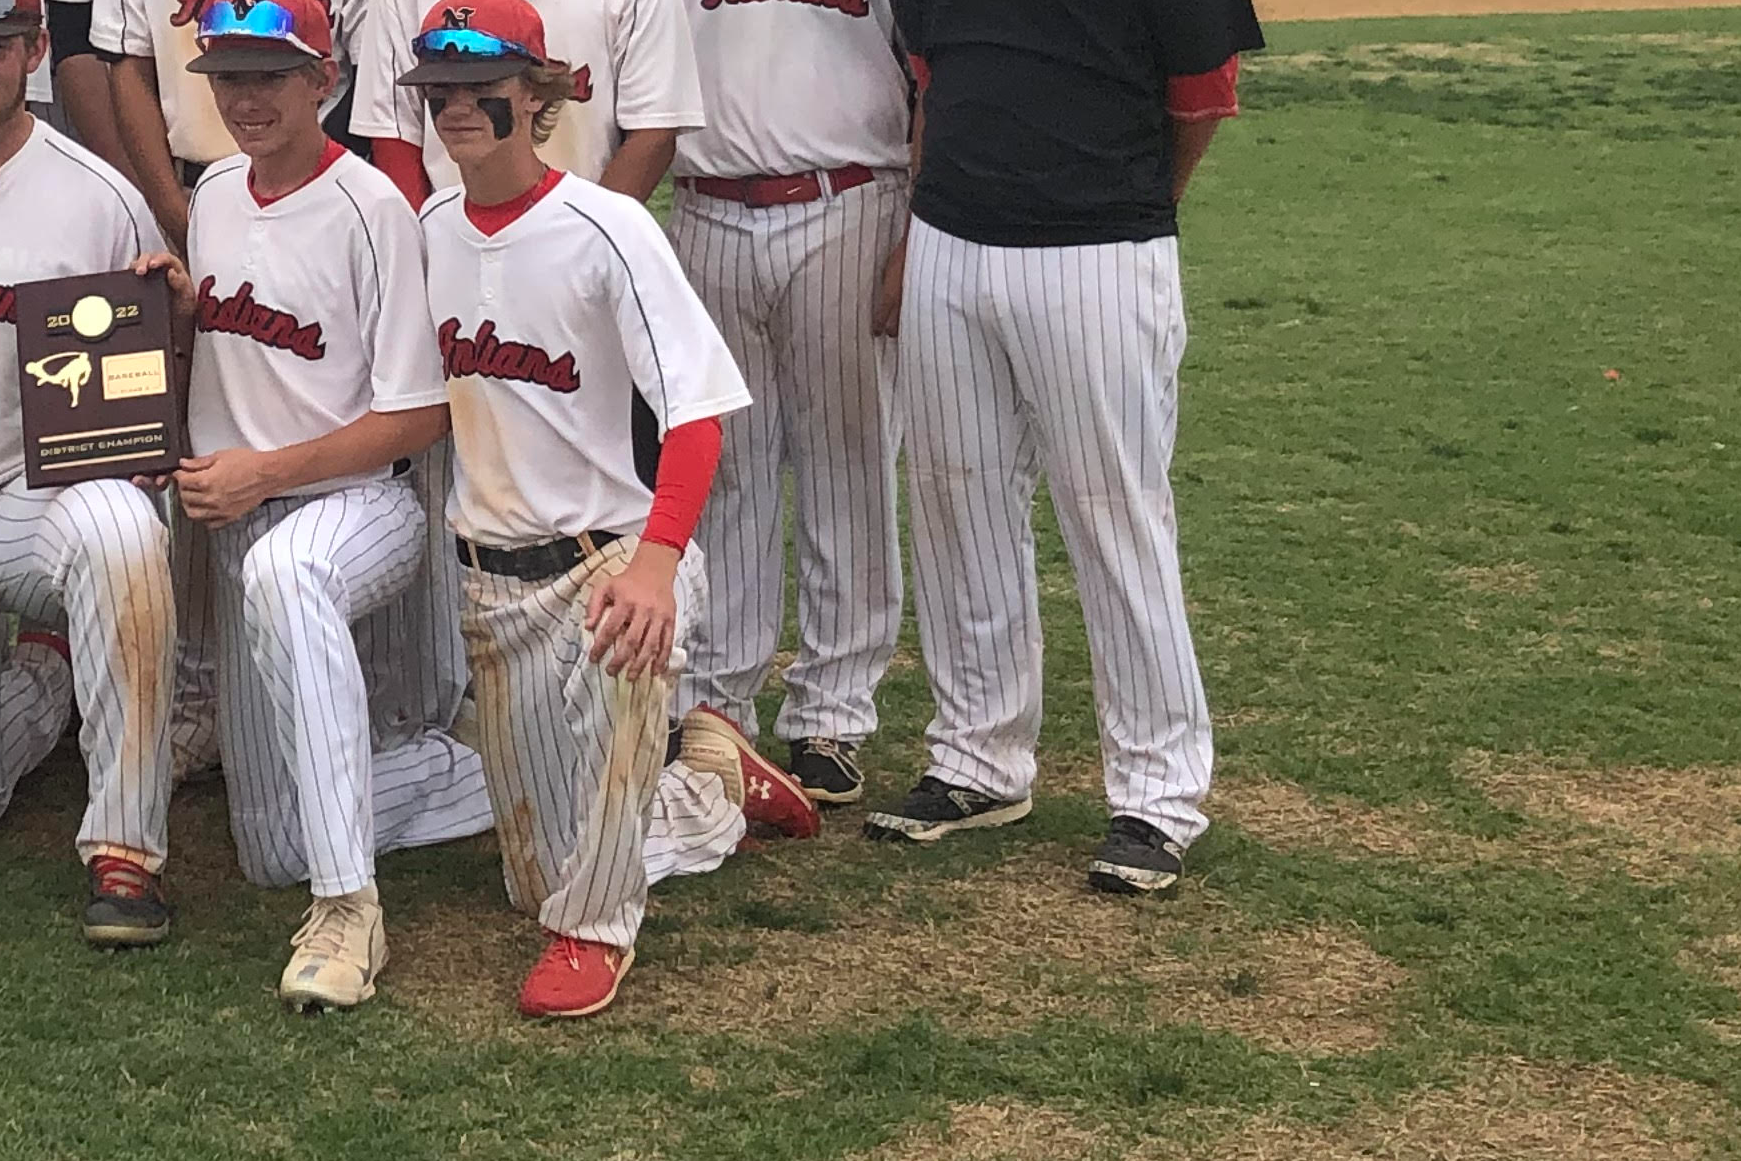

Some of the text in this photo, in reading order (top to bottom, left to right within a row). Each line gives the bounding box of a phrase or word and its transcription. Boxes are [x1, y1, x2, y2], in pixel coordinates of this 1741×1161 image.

[47, 304, 139, 329] 20 22
[108, 370, 161, 381] BASEBALL
[40, 434, 163, 457] DISTRICT CHAMPION
